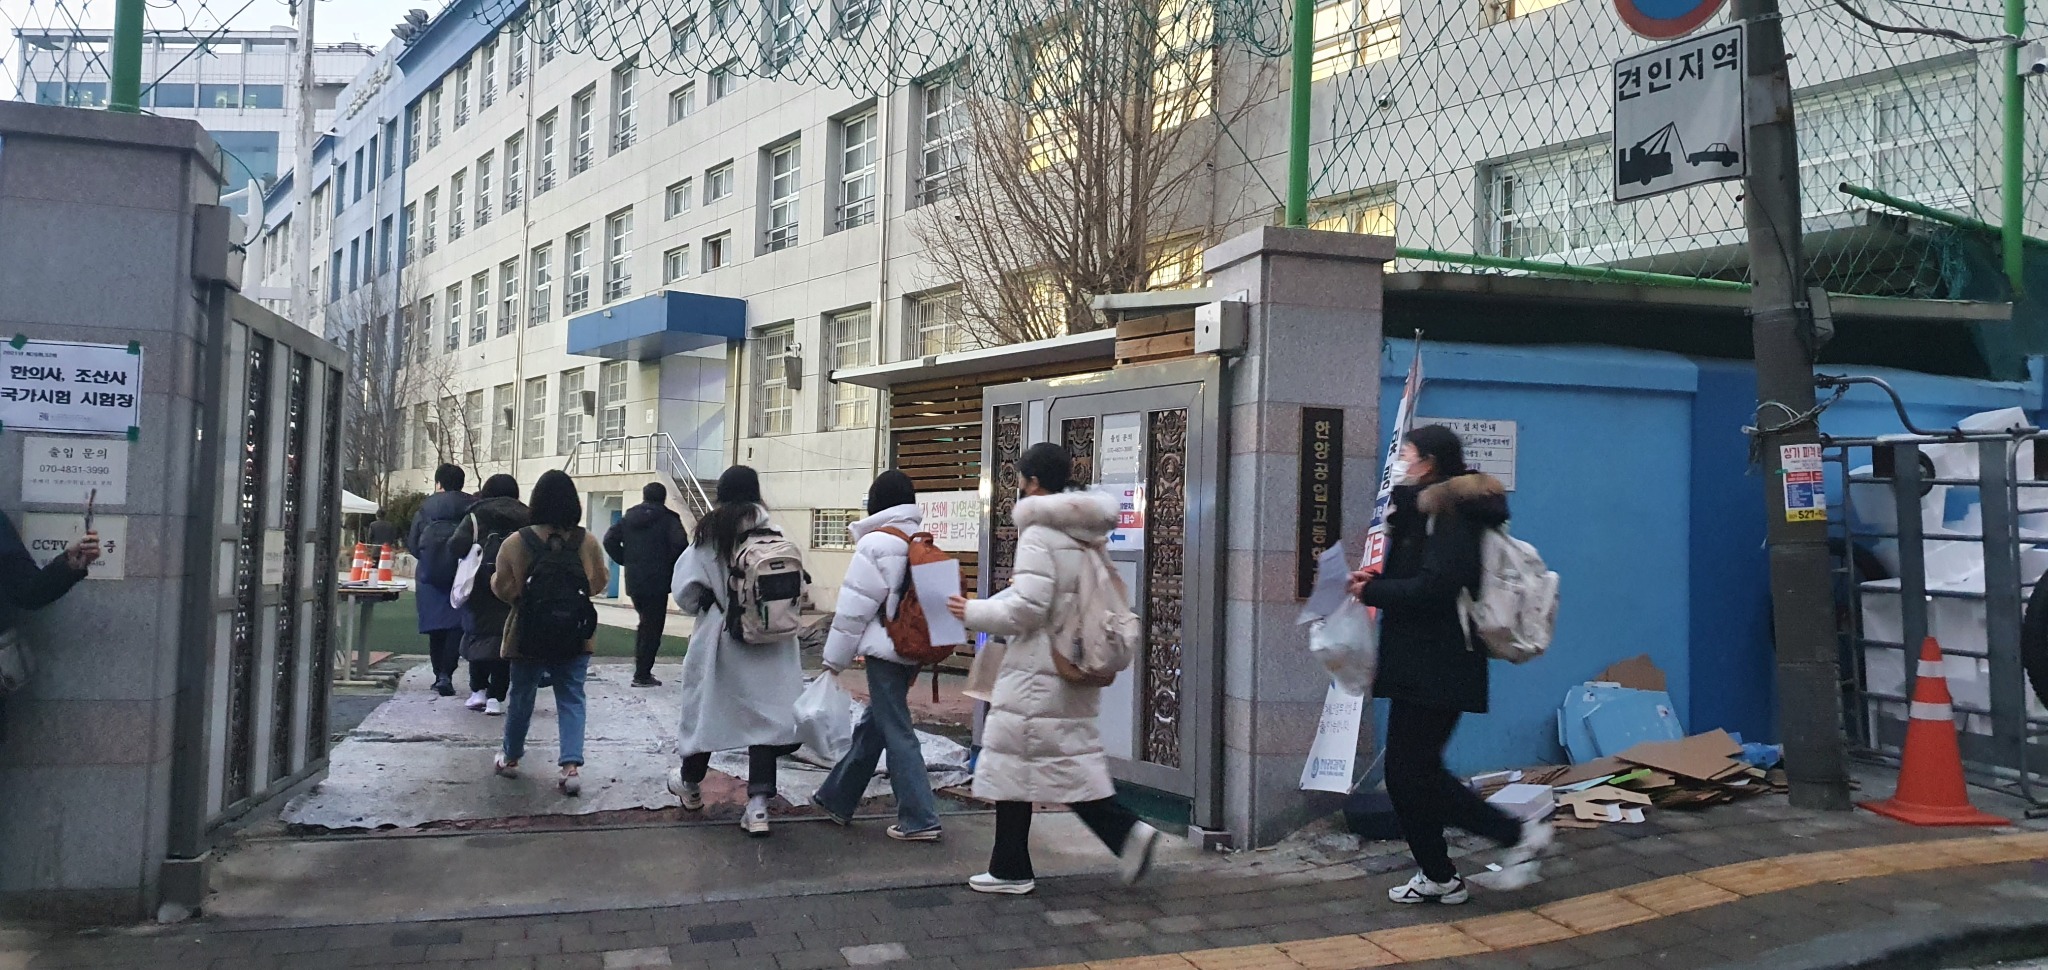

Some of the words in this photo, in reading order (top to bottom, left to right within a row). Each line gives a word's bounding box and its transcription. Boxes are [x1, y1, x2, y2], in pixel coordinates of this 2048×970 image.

[1618, 38, 1738, 101] 견인지역
[10, 365, 65, 382] 한의사,
[74, 368, 127, 385] 조산사
[0, 387, 71, 405] 국가시험
[80, 391, 134, 408] 시험장
[1463, 422, 1497, 432] 설치안내
[48, 446, 74, 459] 출입
[82, 447, 108, 460] 문의
[39, 464, 109, 475] 070-4831-3990
[931, 502, 948, 518] 전에
[32, 539, 69, 551] CCTV
